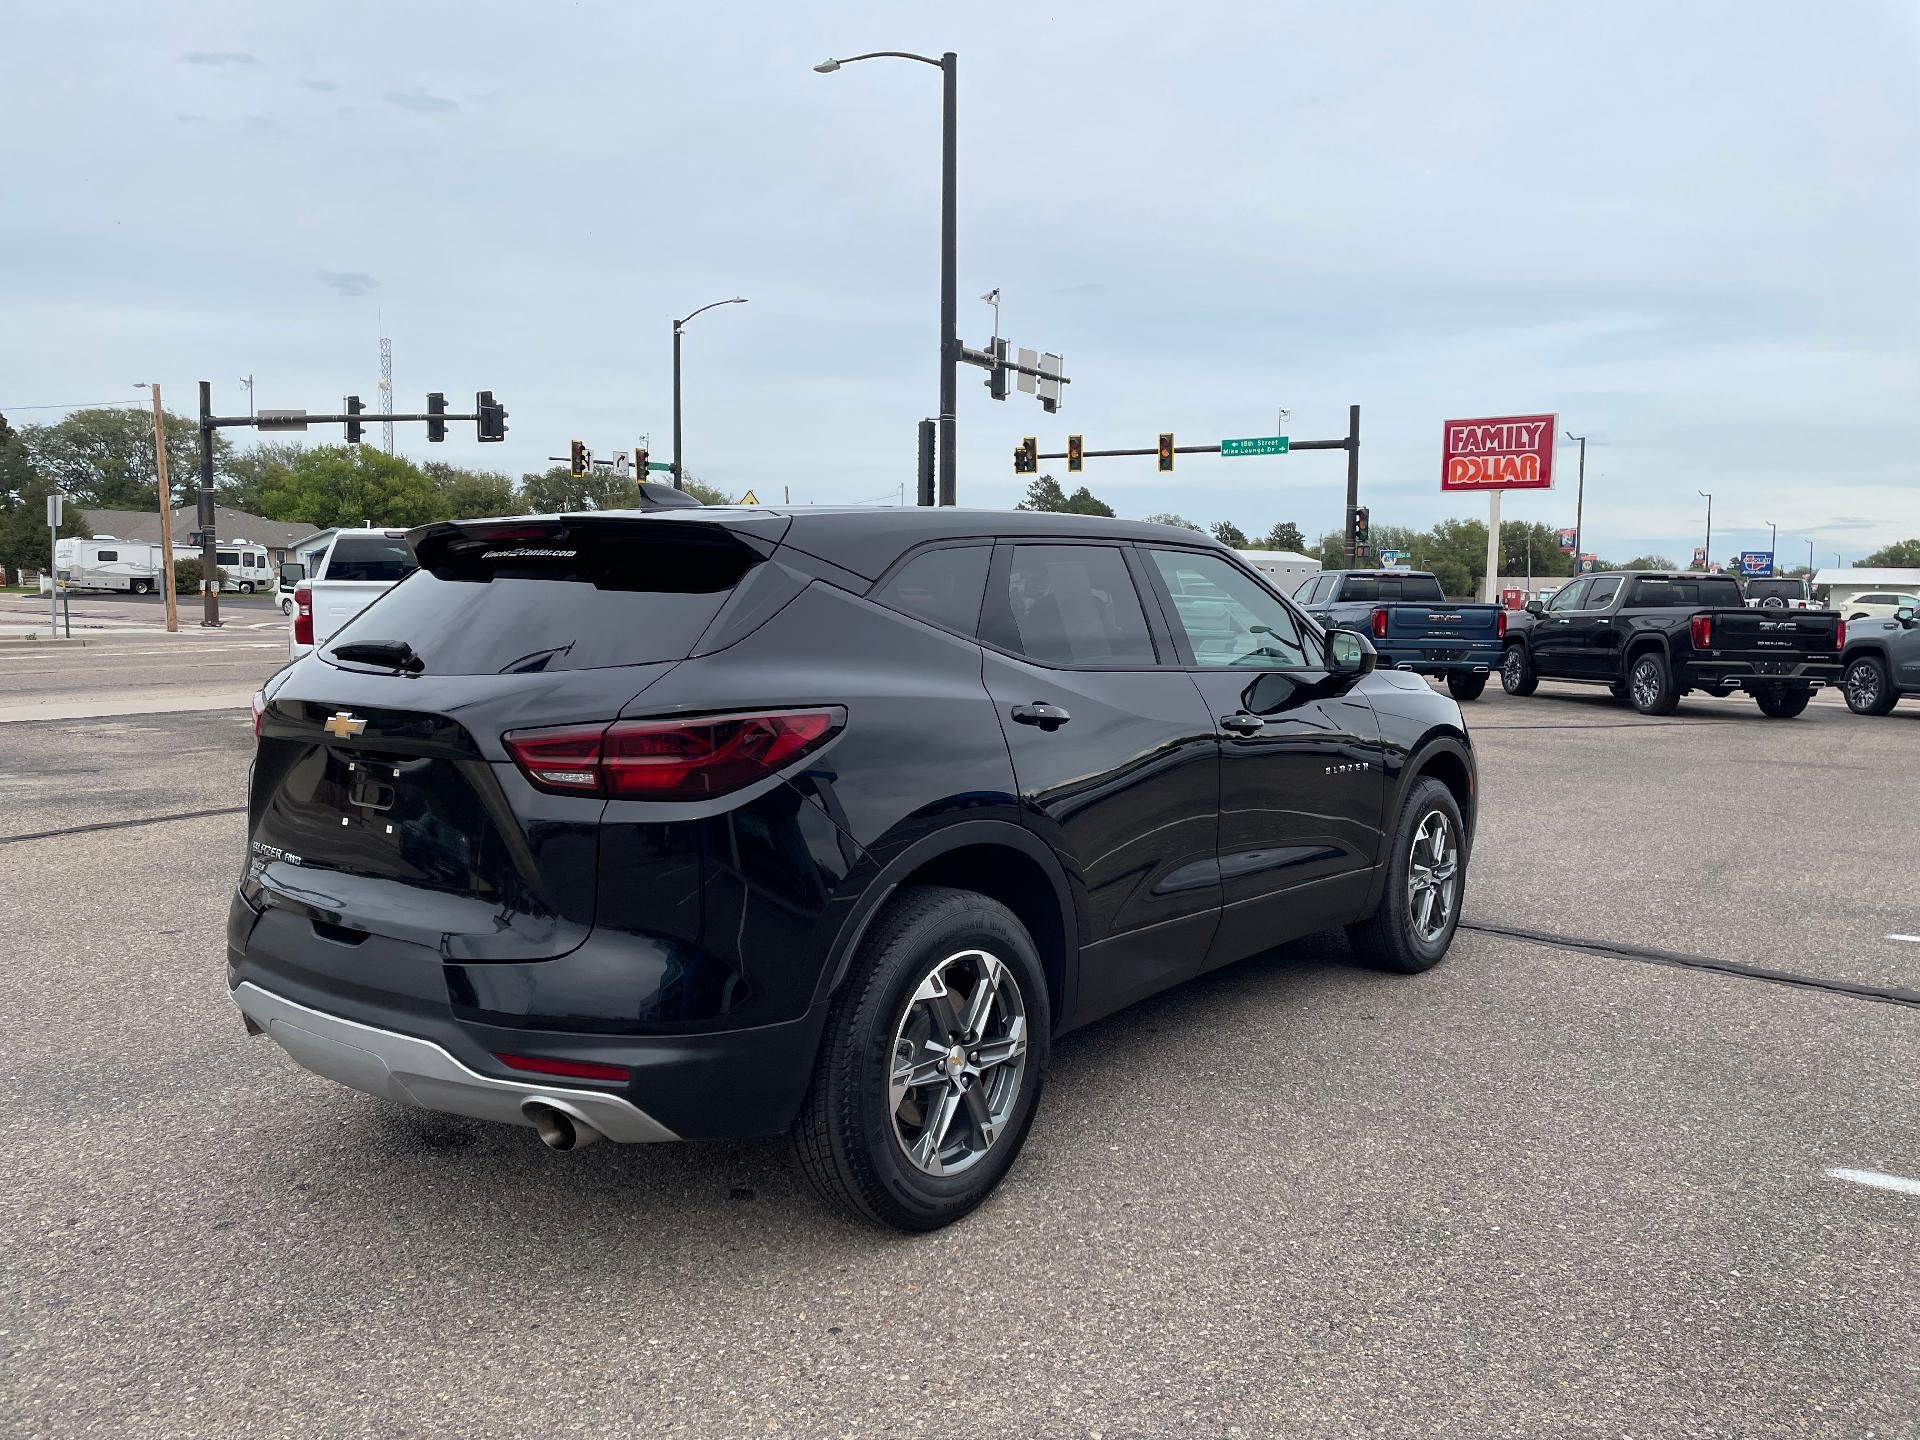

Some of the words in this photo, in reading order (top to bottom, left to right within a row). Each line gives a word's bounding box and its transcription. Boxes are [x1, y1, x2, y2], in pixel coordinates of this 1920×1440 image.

[1449, 421, 1547, 453] FAMILY
[1448, 453, 1541, 484] DOLLAR
[1759, 621, 1797, 631] GMC
[1325, 762, 1369, 775] BLAZER
[252, 841, 283, 860] BLAZER
[284, 852, 302, 866] AWD
